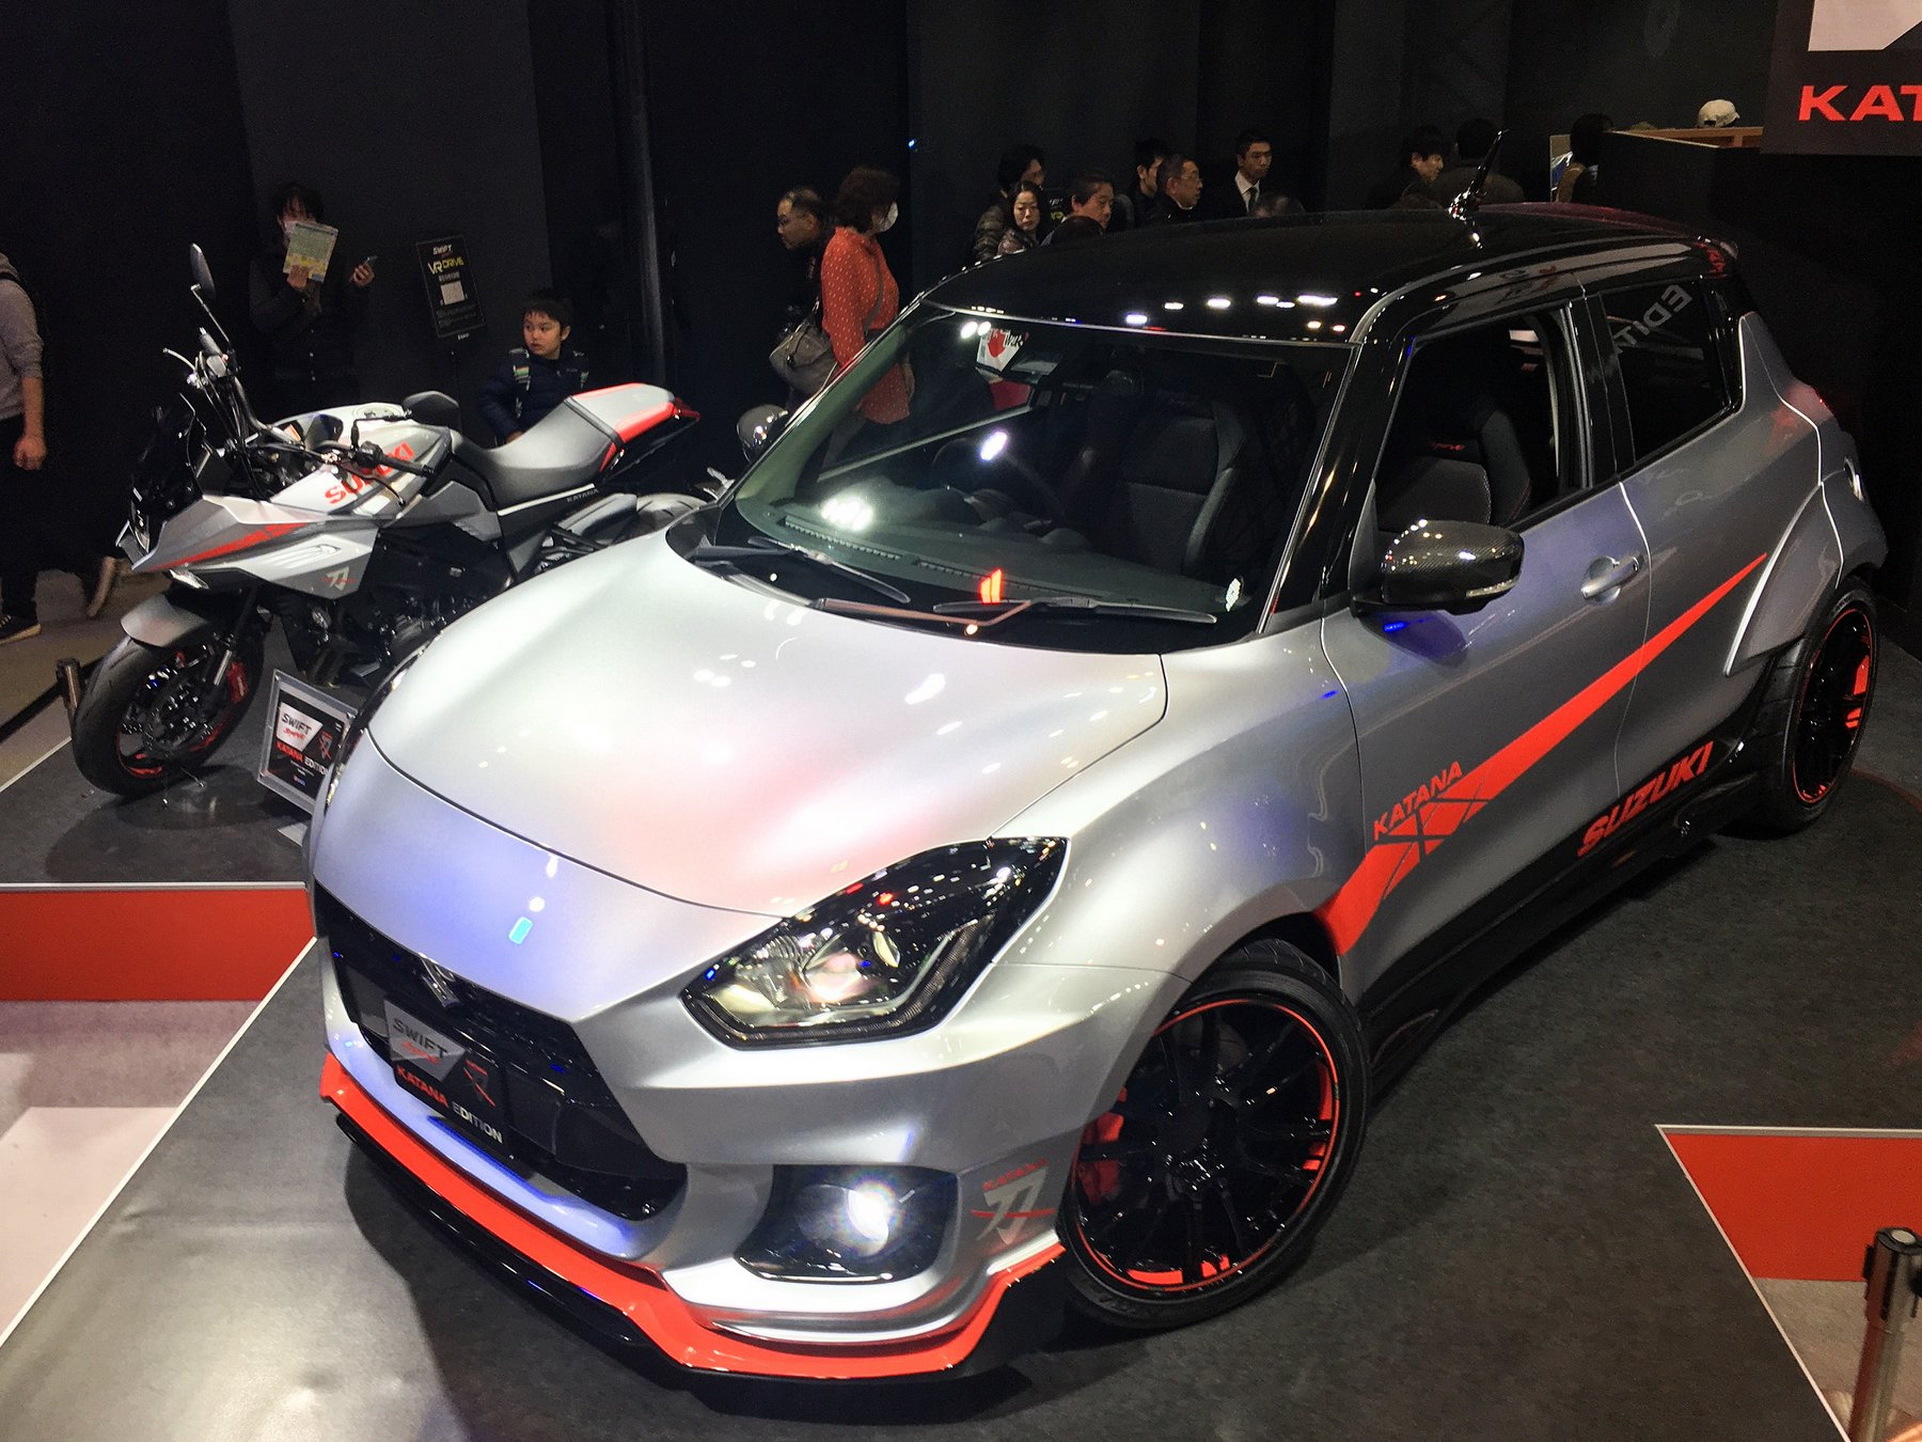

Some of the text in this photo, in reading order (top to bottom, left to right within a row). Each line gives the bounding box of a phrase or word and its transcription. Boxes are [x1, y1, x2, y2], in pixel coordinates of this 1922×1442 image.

[281, 712, 312, 735] SWIFT
[304, 756, 328, 776] EDITIO
[1373, 760, 1463, 841] KATANA
[1577, 740, 1714, 857] SUZUKI
[393, 1018, 449, 1059] SWIFT
[395, 1064, 449, 1108] KATANA
[452, 1101, 503, 1143] EDITION
